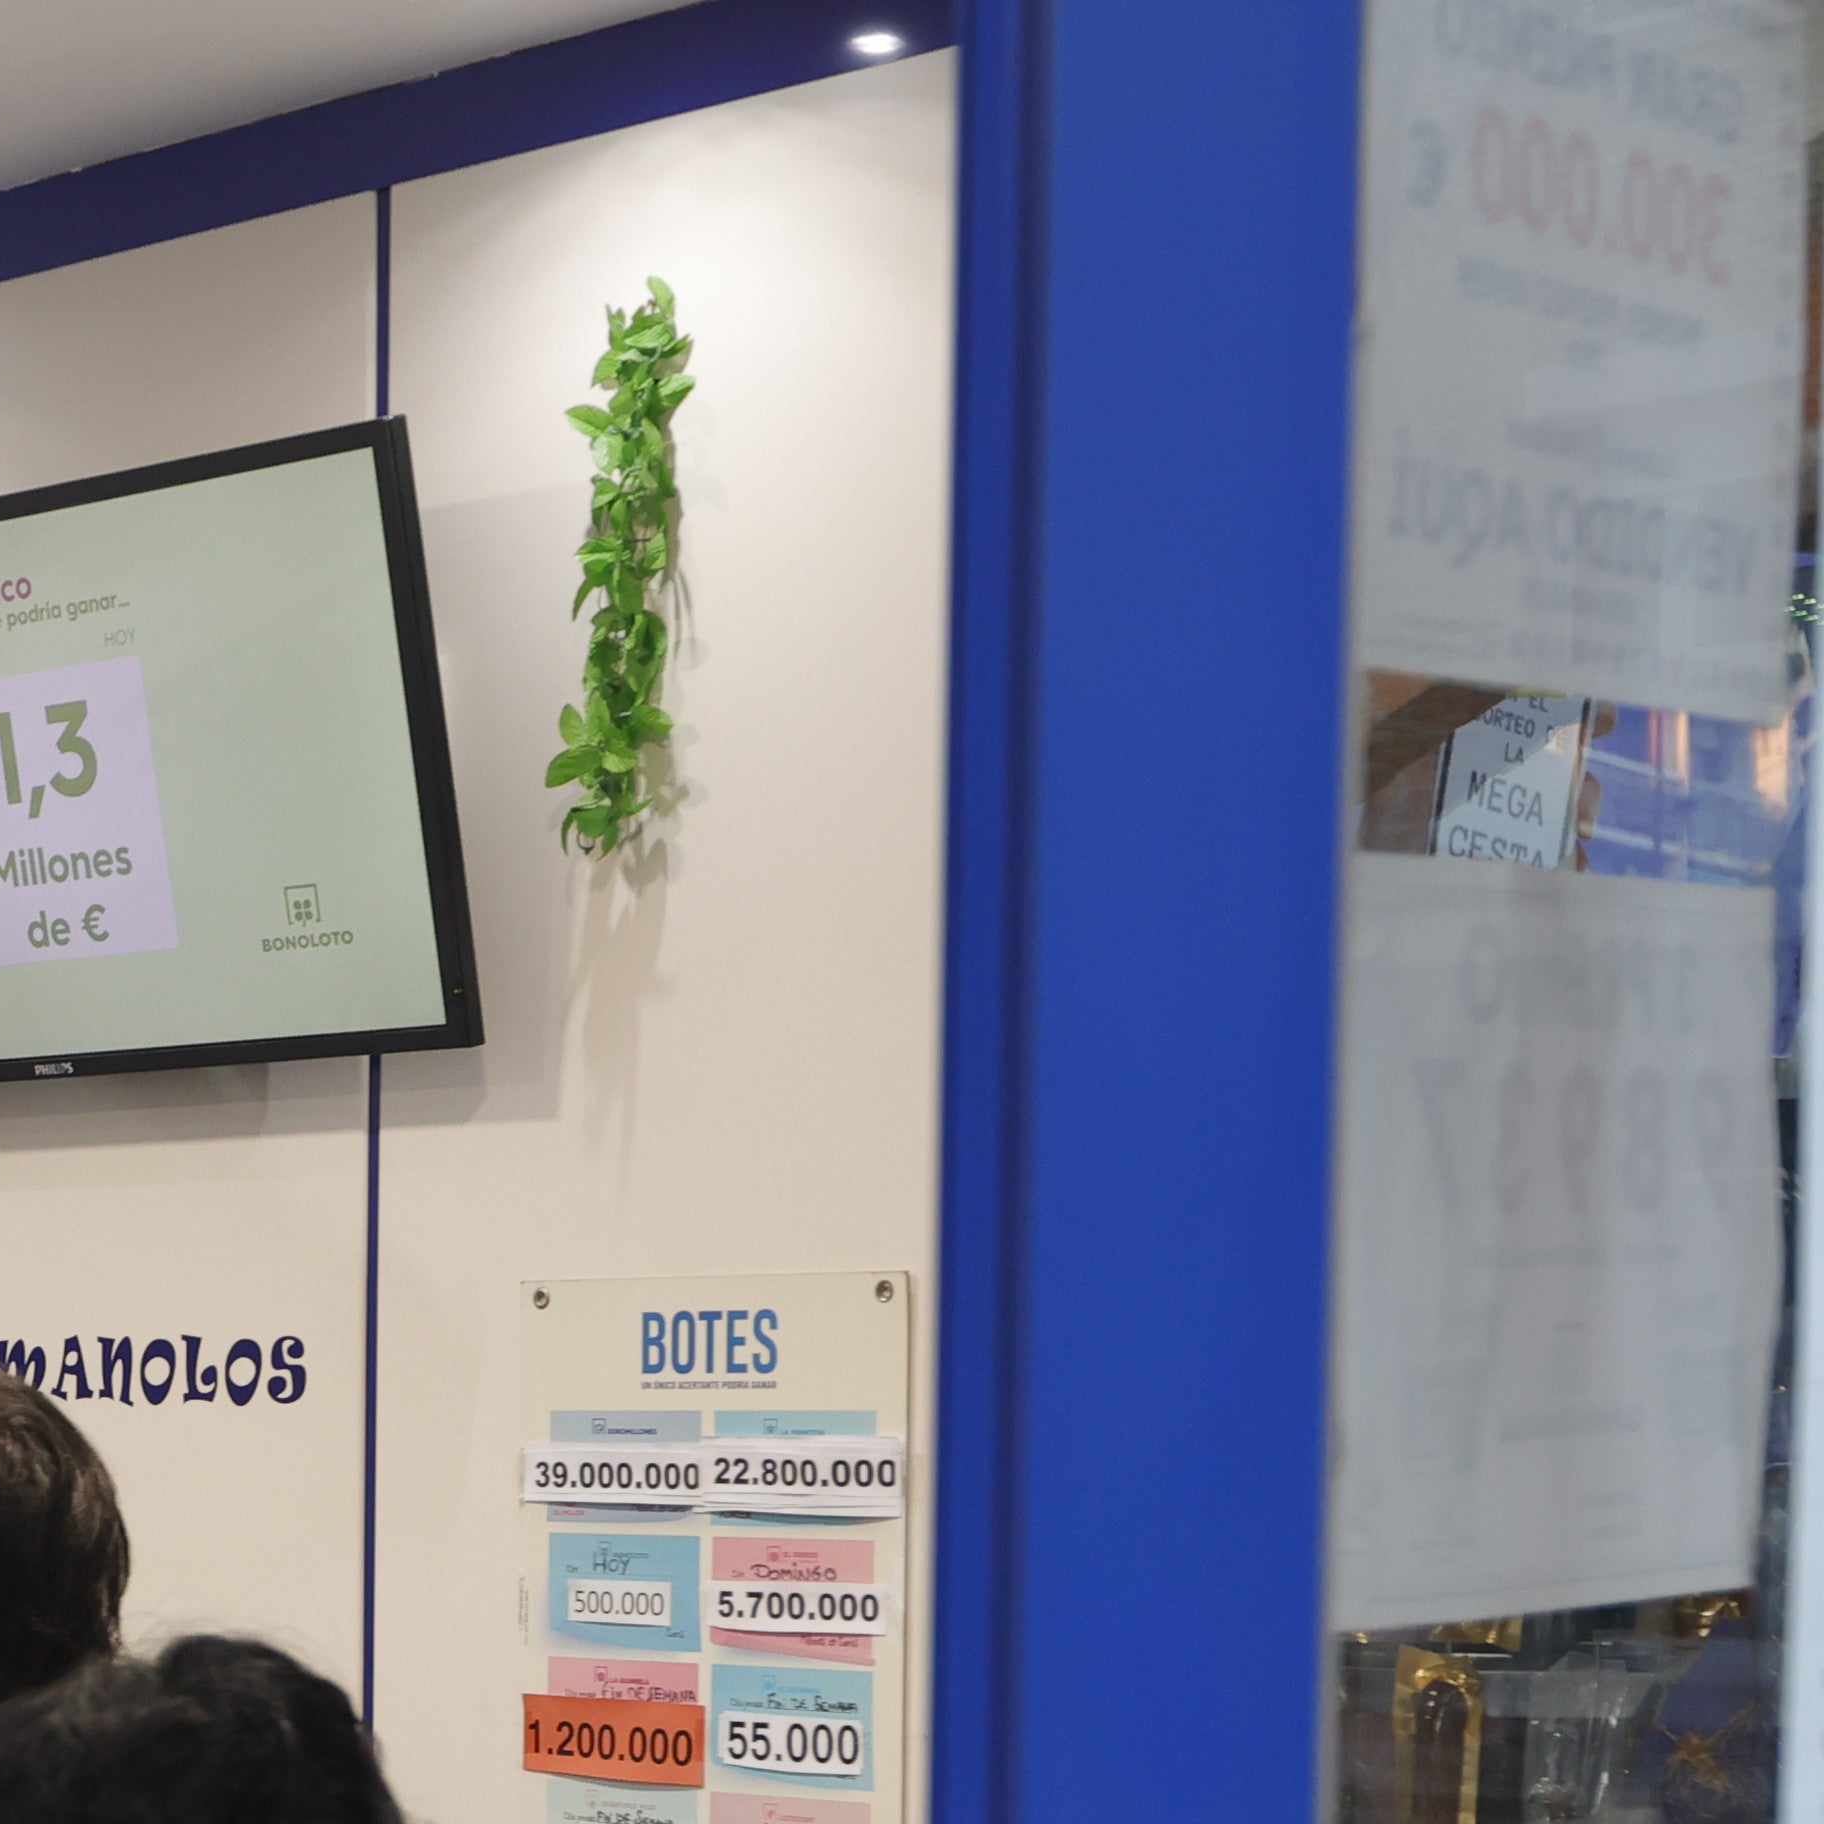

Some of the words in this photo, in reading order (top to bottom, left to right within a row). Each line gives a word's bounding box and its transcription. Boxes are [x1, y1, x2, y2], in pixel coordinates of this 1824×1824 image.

[6, 599, 62, 633] podría
[104, 628, 136, 648] HOY
[1504, 742, 1524, 765] LA
[1468, 769, 1542, 827] MEGA
[28, 911, 71, 950] de
[81, 903, 110, 942] €
[261, 931, 353, 953] BONOLOTO
[642, 1309, 778, 1374] BOTES
[535, 1462, 700, 1490] 39.000.000
[714, 1458, 895, 1487] 22.800.000
[593, 1550, 630, 1575] HOY
[573, 1590, 665, 1616] 500.000
[718, 1591, 879, 1622] 5.700.000
[527, 1719, 693, 1766] 1.200.000
[727, 1721, 859, 1765] 55.000
